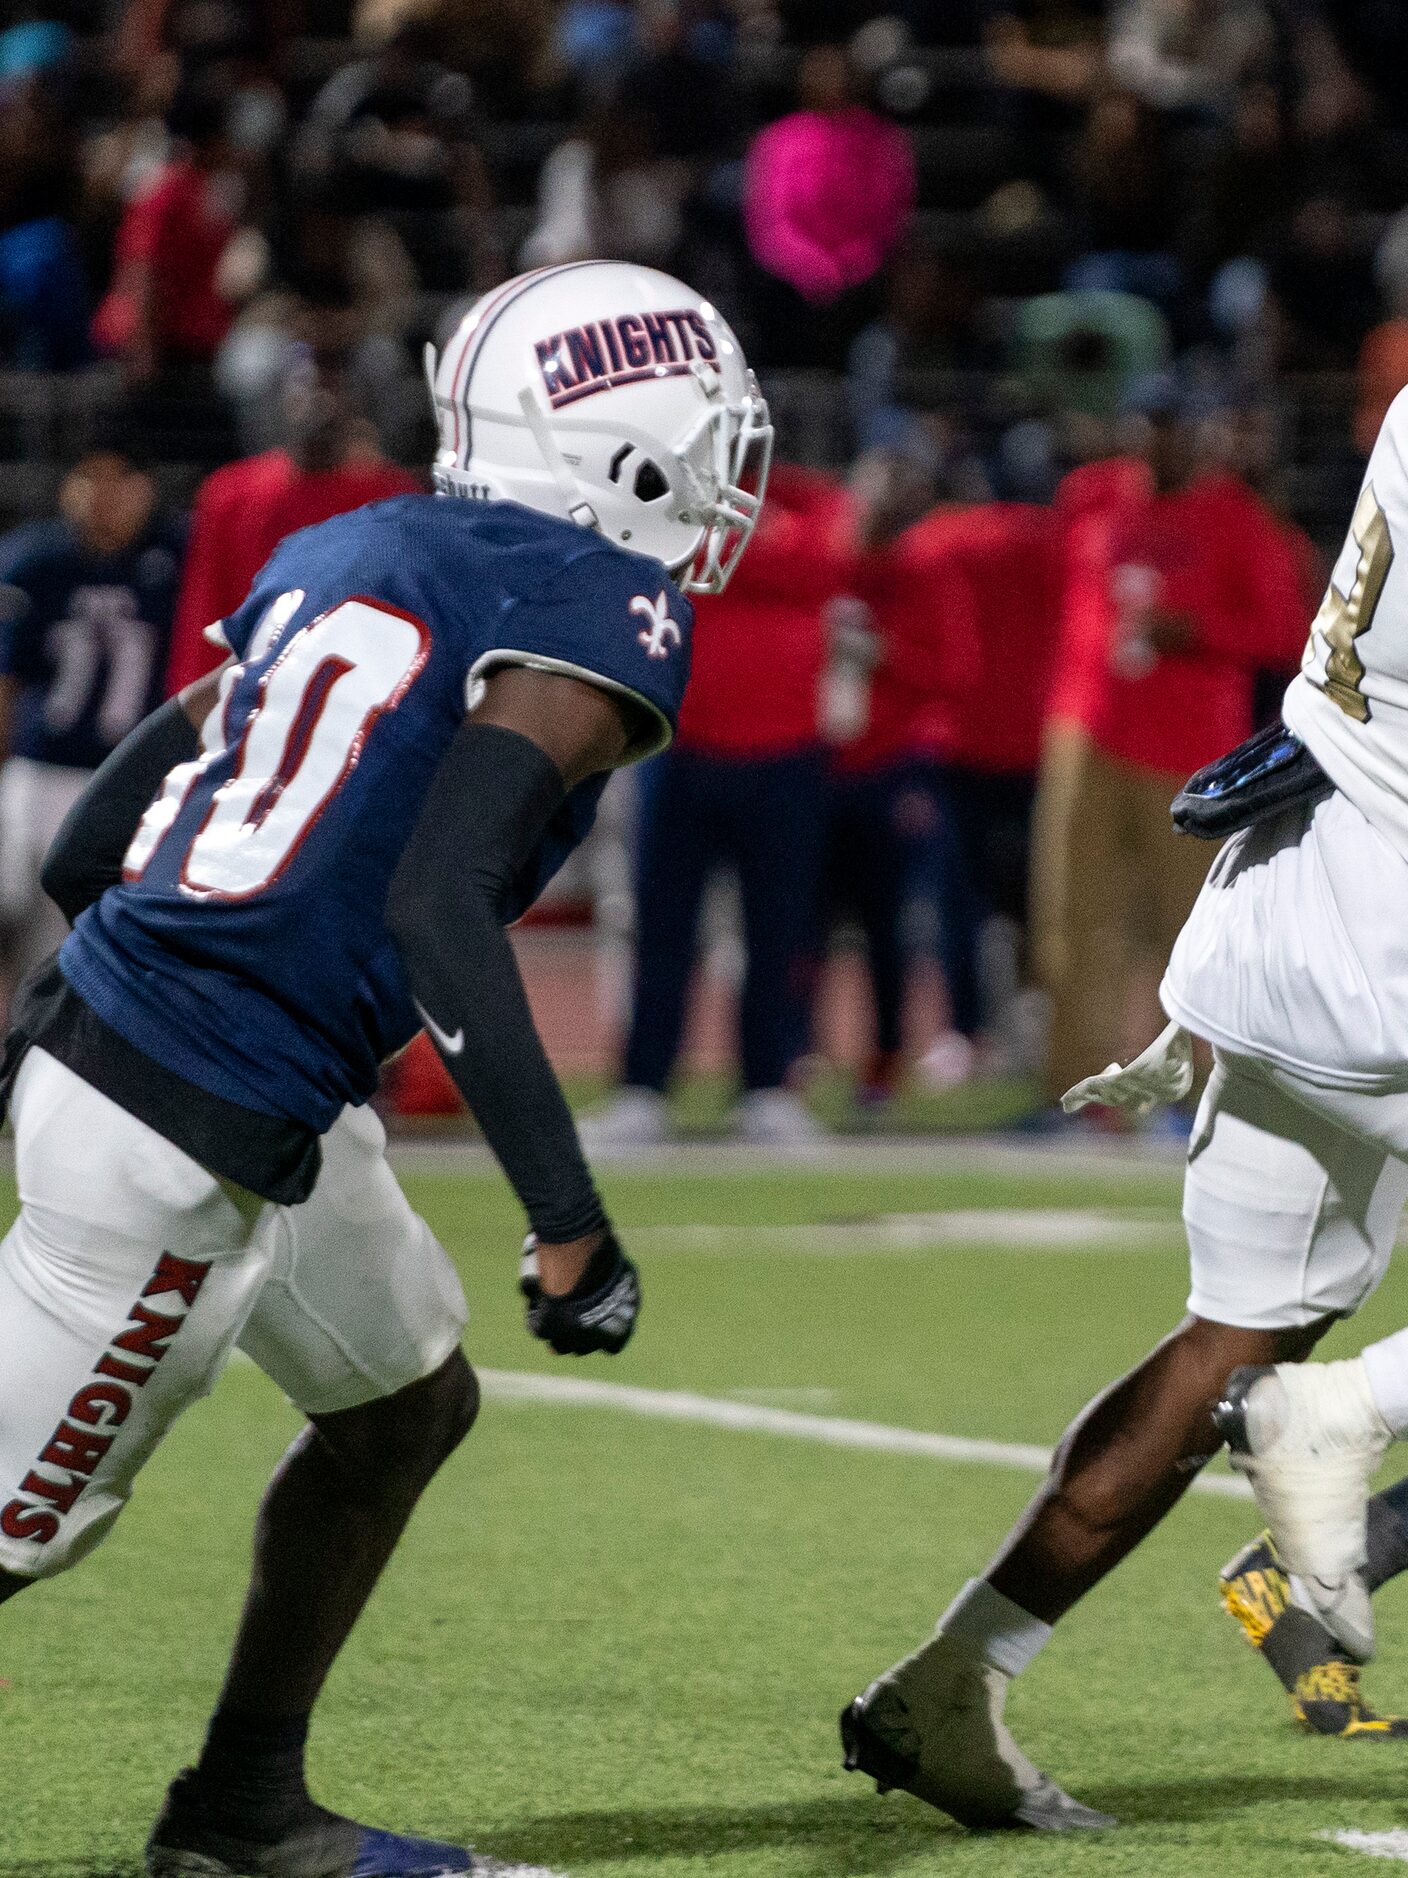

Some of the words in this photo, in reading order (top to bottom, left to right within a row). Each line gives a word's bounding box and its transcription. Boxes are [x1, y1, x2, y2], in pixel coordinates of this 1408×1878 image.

[533, 308, 718, 397] KNIGHTS
[121, 588, 433, 904] 10
[0, 1249, 214, 1545] KNIGHTS
